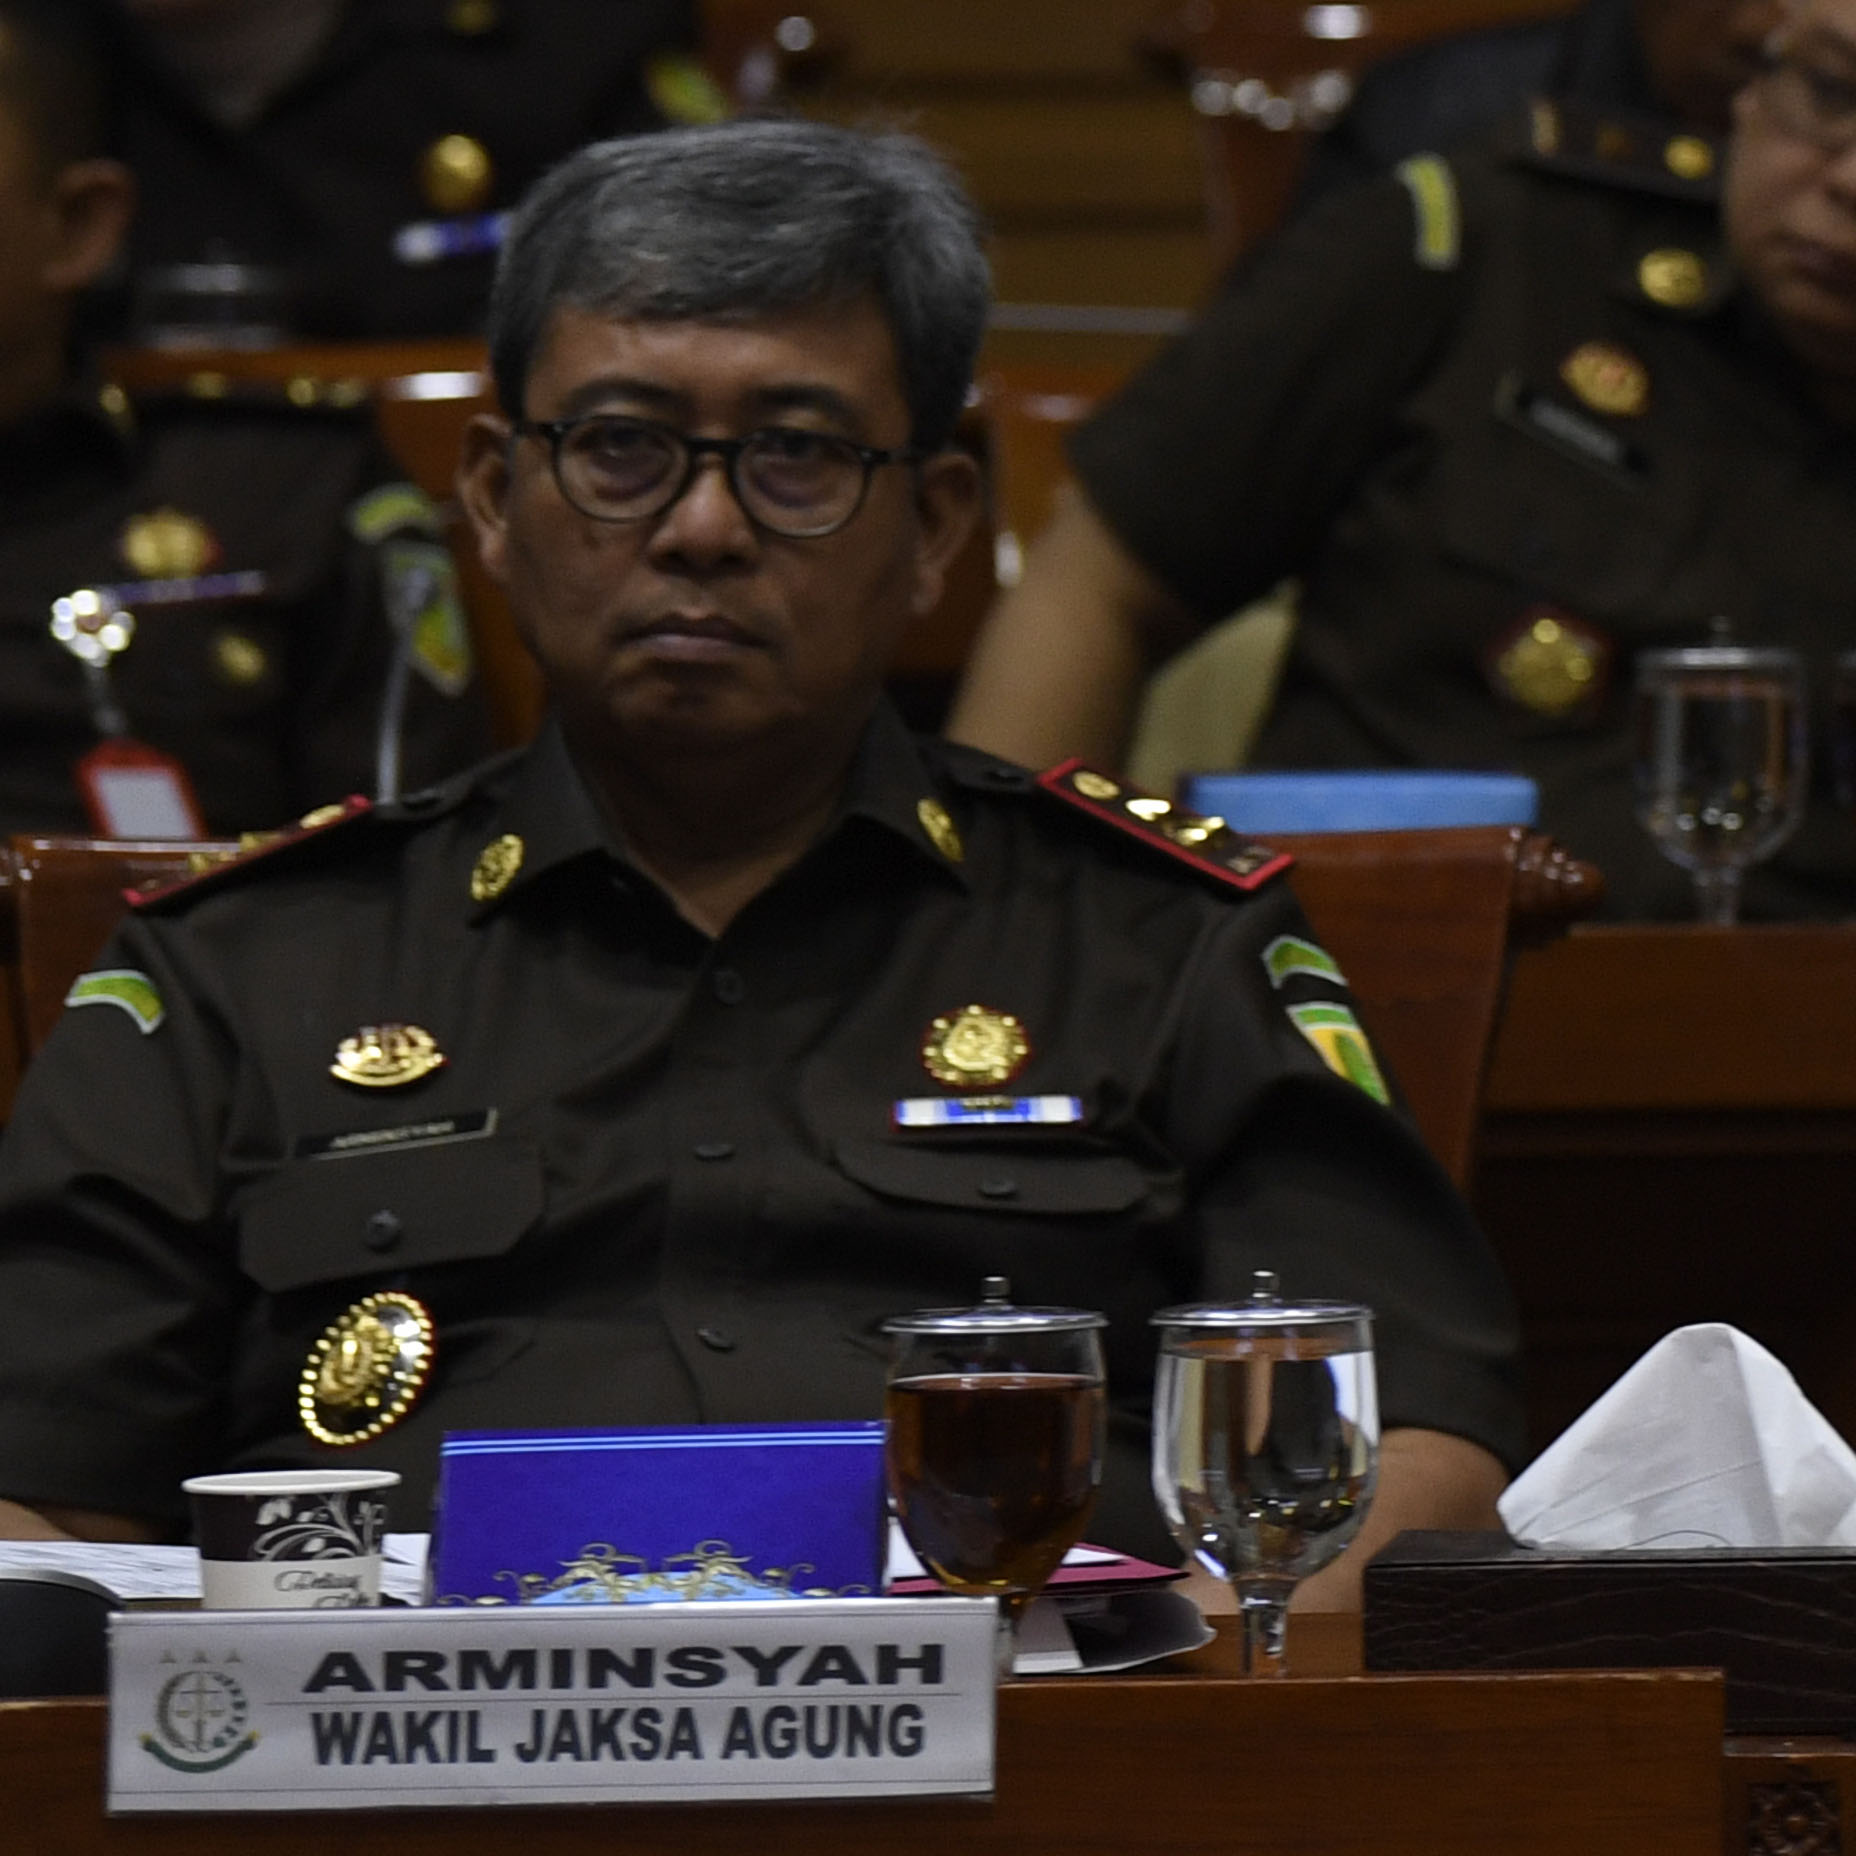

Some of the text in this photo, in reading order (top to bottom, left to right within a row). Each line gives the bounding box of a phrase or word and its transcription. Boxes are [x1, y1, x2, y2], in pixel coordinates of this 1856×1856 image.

[302, 1643, 944, 1695] ARMINSYAH
[310, 1703, 924, 1766] WAKIL JAKSA AGUNG
